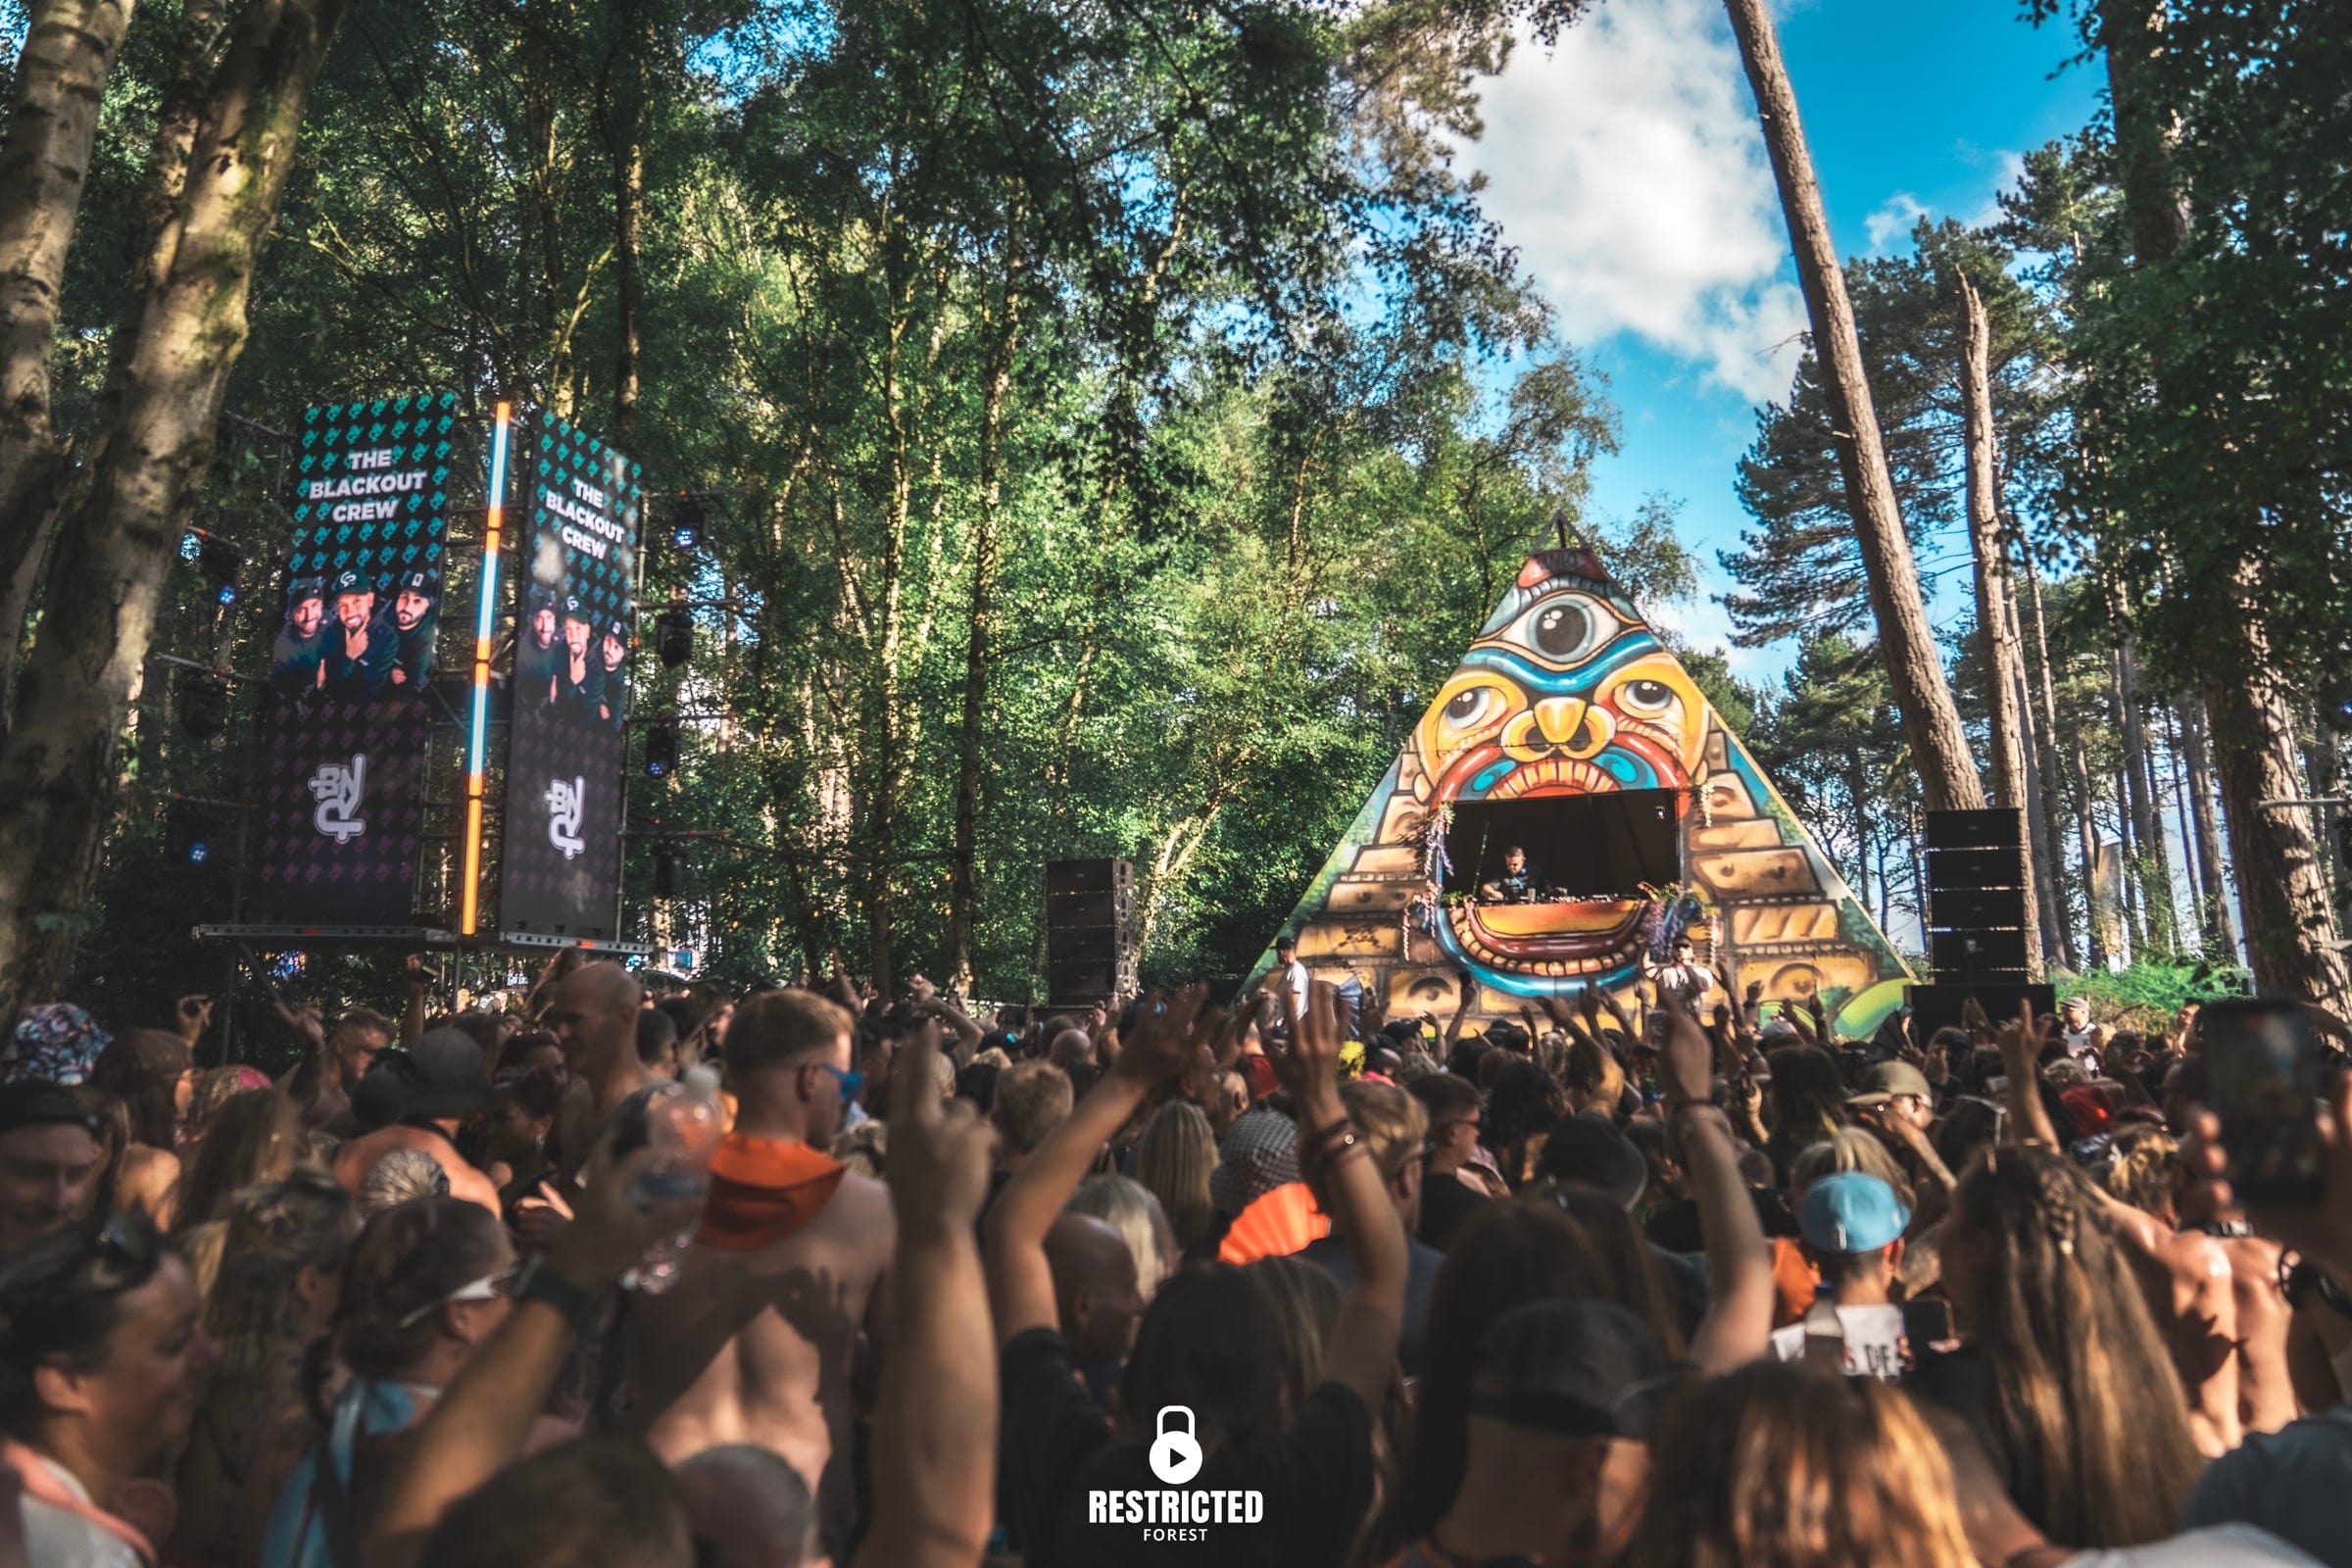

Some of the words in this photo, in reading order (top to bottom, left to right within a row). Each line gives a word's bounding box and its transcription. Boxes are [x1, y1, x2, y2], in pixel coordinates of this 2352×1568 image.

[348, 449, 392, 470] THE
[309, 470, 428, 500] BLACKOUT
[572, 477, 604, 509] THE
[332, 500, 399, 523] CREW
[546, 490, 625, 544] BLACKOUT
[562, 525, 608, 560] CREW
